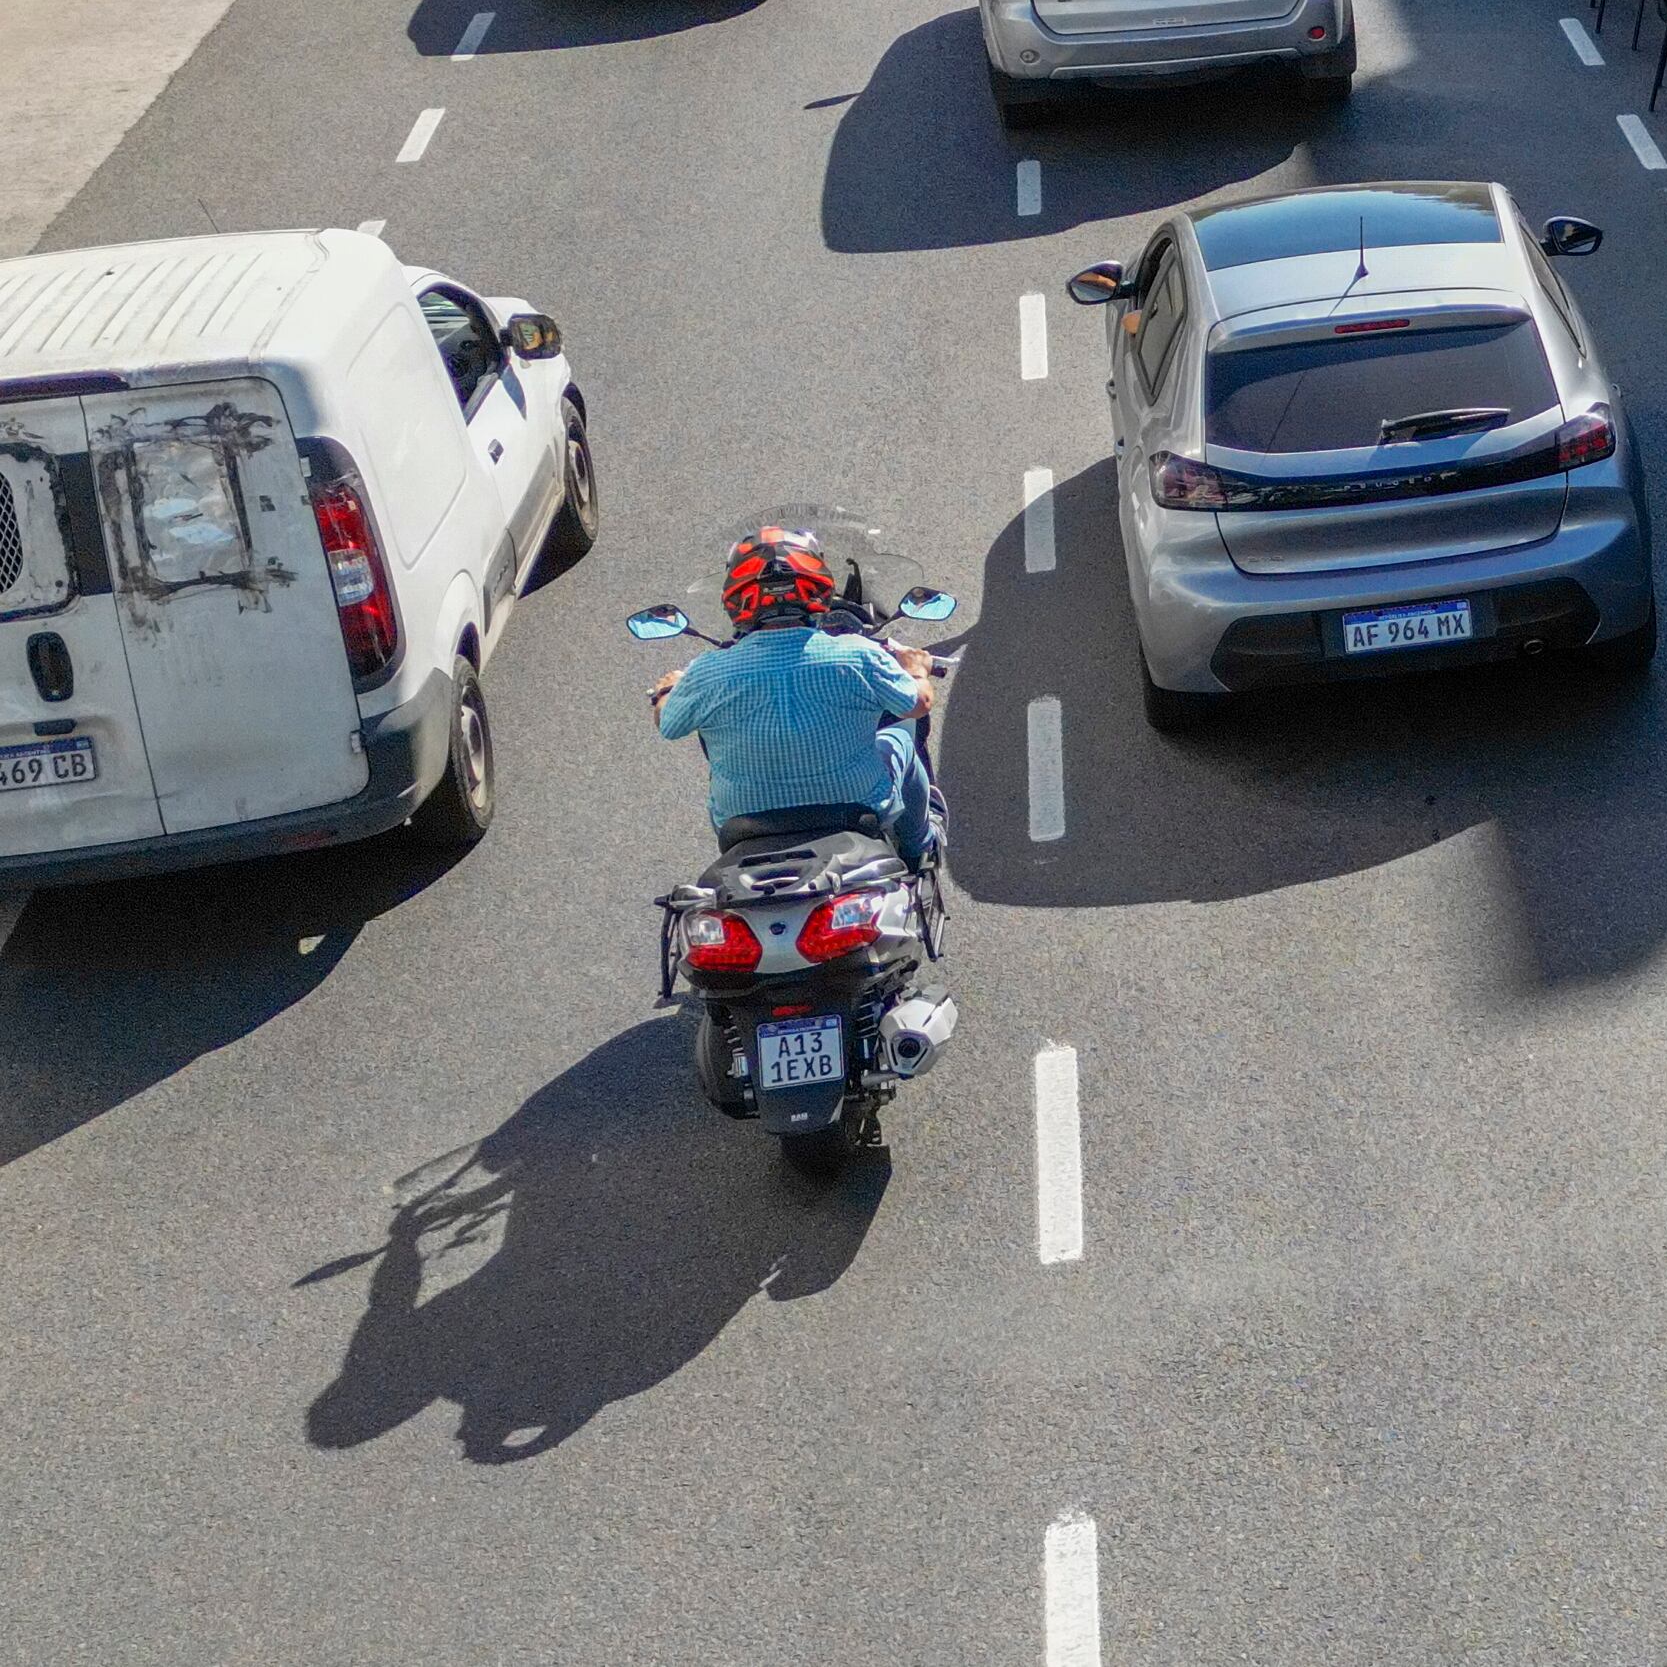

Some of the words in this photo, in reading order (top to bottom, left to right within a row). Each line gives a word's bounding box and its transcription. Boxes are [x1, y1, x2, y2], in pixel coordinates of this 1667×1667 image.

[1353, 623, 1379, 647] AF
[1387, 618, 1430, 643] 964
[1436, 613, 1465, 637] MX
[53, 754, 87, 779] CB
[778, 1031, 823, 1059] A13
[770, 1054, 833, 1084] 1EXB
